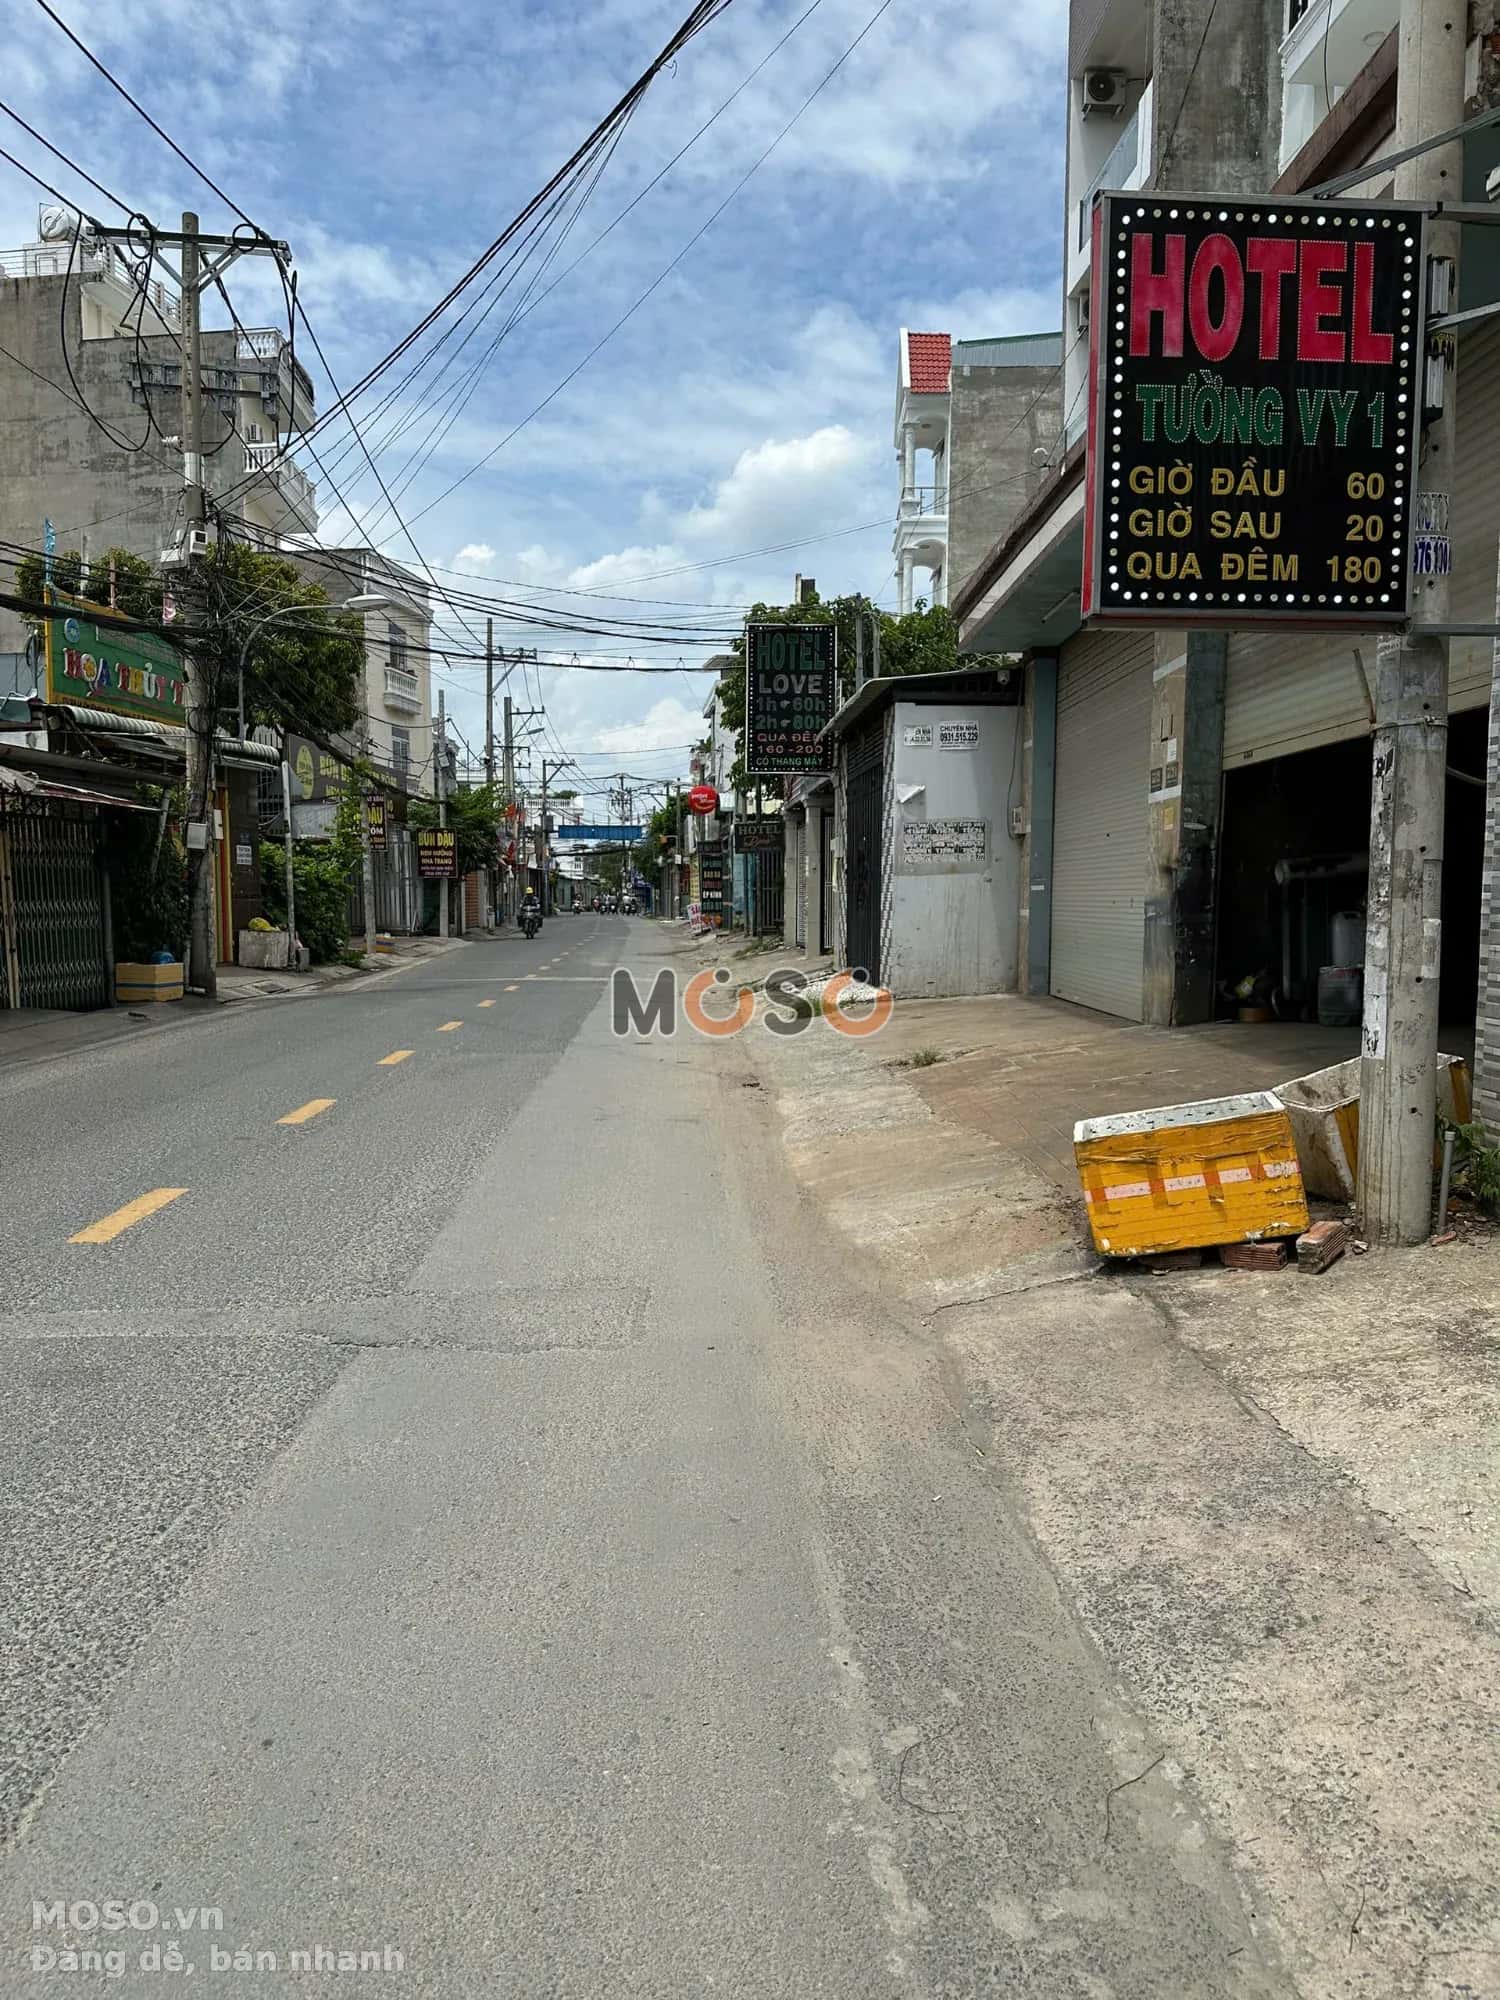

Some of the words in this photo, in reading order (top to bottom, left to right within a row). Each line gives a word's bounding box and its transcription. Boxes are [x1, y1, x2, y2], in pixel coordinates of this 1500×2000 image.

[1129, 232, 1395, 364] HOTEL
[1136, 369, 1284, 447] TƯỜNG
[1296, 388, 1359, 448] VY
[1367, 391, 1385, 448] 1
[1129, 458, 1194, 495] GIỜ
[1210, 456, 1286, 497] ĐẦU
[1346, 472, 1385, 501] 60
[1128, 501, 1193, 538] GIỜ
[1210, 511, 1281, 540] SAU
[1345, 514, 1384, 542] 20
[1126, 550, 1202, 580] QUA
[1221, 546, 1299, 582] ĐÊM
[1326, 556, 1382, 584] 180
[756, 632, 826, 671] HOTEL
[758, 673, 824, 695] LOVE
[756, 697, 777, 712] 1h
[755, 714, 778, 730] 2h
[757, 733, 788, 743] QUA
[756, 755, 769, 766] CÓ
[770, 757, 802, 766] THANG
[738, 825, 781, 835] HOTEL
